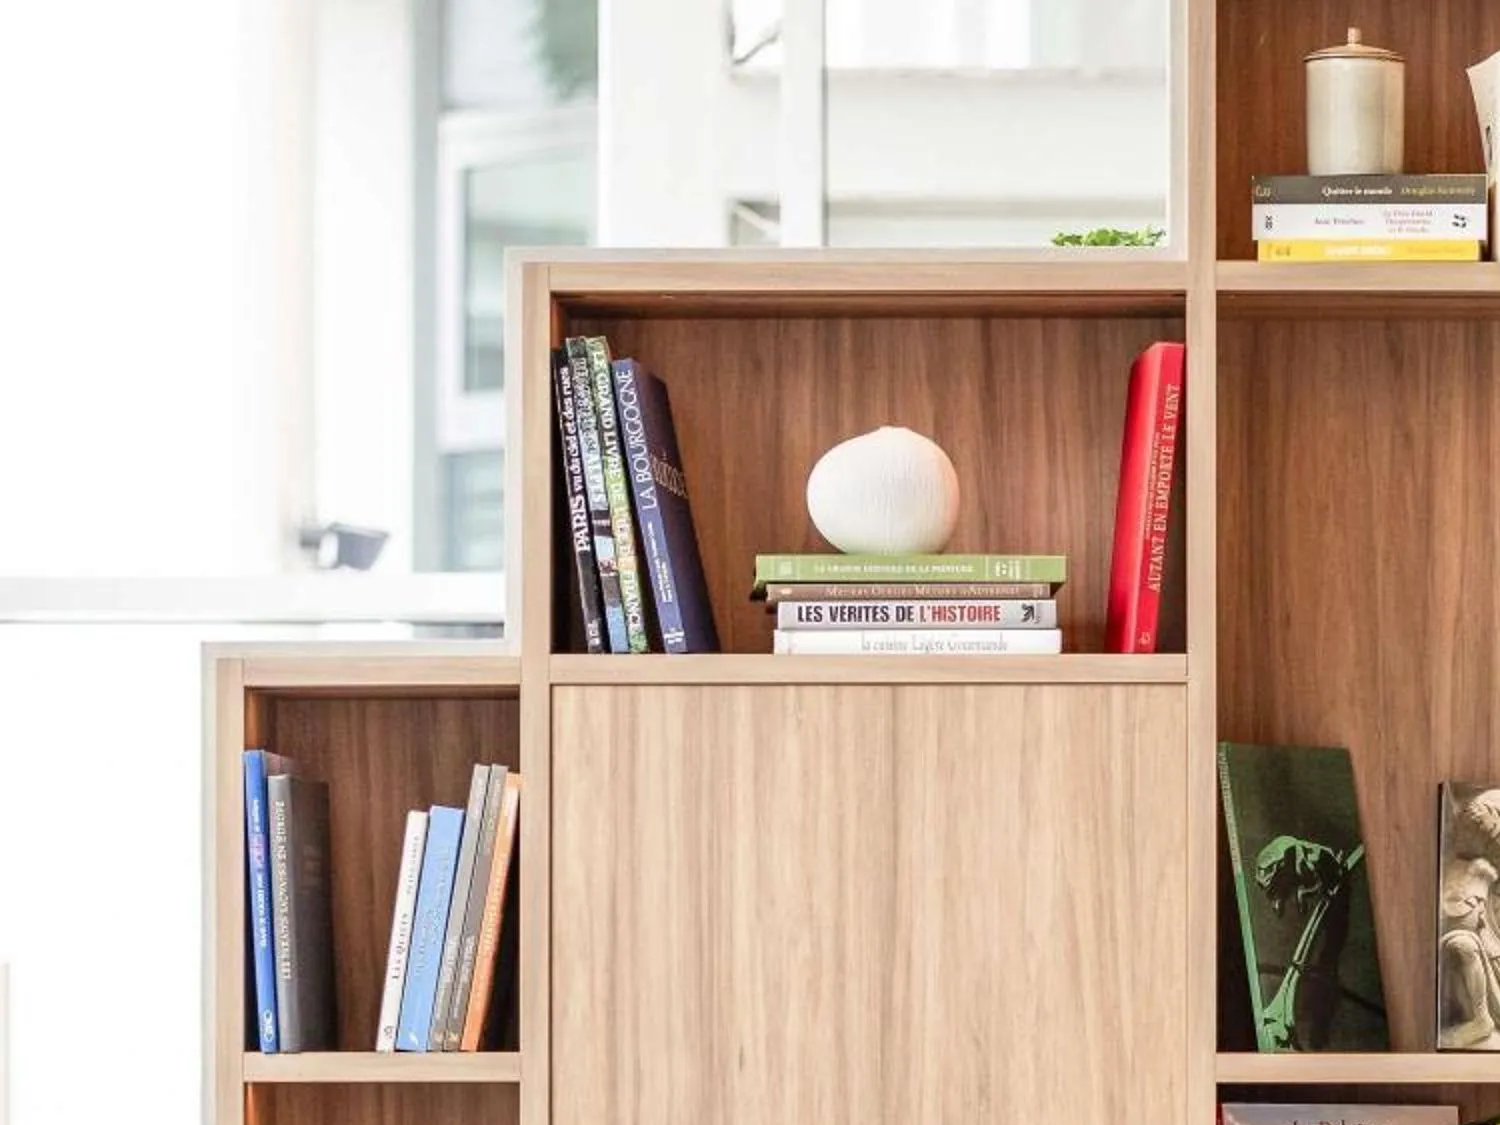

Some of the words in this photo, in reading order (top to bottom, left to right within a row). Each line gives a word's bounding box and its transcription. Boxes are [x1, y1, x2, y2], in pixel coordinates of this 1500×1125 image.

[592, 350, 607, 369] LE
[595, 371, 615, 428] GRAND
[1162, 383, 1180, 419] VENT
[615, 369, 652, 483] BOURGOGNE
[1163, 423, 1176, 440] LE
[603, 431, 622, 477] LIVRE
[1158, 445, 1175, 508] EMPORTE
[638, 486, 656, 510] LA
[571, 494, 591, 552] PARIS
[1153, 513, 1167, 531] EN
[1147, 536, 1166, 592] AUTANT
[622, 569, 644, 631] FRANCE
[798, 605, 823, 622] LES
[896, 605, 915, 622] DE
[920, 605, 1001, 623] L'HISTOIRE
[862, 630, 871, 651] la
